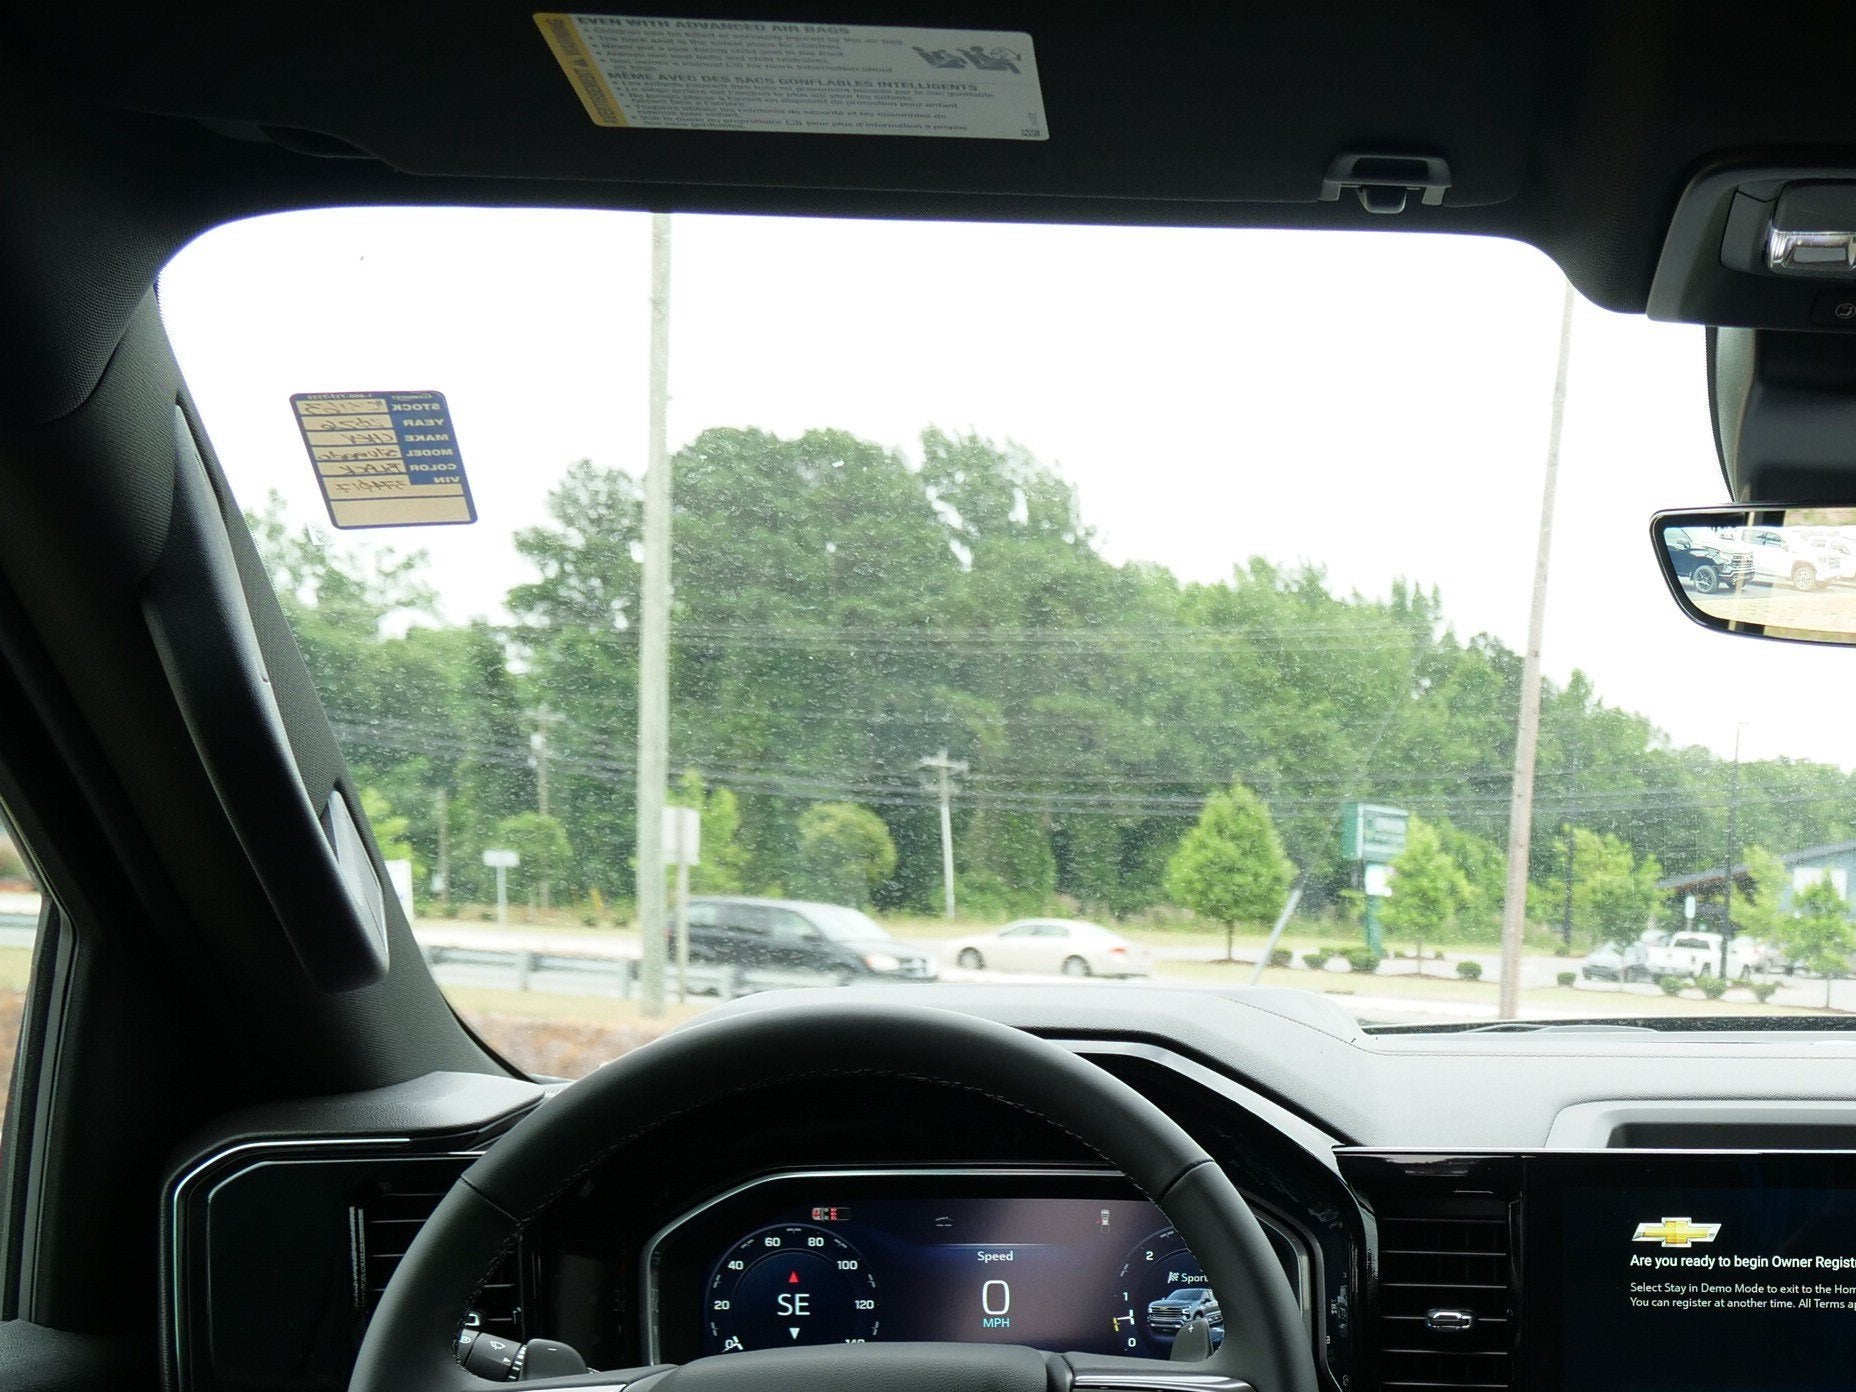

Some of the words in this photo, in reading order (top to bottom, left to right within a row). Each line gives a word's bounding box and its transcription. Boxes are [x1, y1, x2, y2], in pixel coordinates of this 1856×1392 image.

[578, 16, 621, 25] EVEN
[625, 19, 669, 27] WITH
[764, 1237, 781, 1248] 60
[807, 1237, 825, 1248] 80
[977, 1250, 1014, 1263] Speed
[1146, 1251, 1154, 1261] 2
[727, 1260, 744, 1271] 40
[837, 1260, 858, 1271] 100
[1630, 1254, 1652, 1267] Are
[1655, 1256, 1678, 1269] you
[1680, 1254, 1715, 1270] ready
[1718, 1256, 1731, 1267] to
[1734, 1254, 1769, 1270] begin
[1771, 1255, 1813, 1268] Owner
[1630, 1282, 1662, 1293] Select
[1664, 1282, 1687, 1295] Stay
[1689, 1283, 1699, 1293] in
[1701, 1283, 1732, 1293] Demo
[1734, 1283, 1765, 1294] Mode
[1766, 1284, 1778, 1294] to
[1780, 1283, 1800, 1294] exit
[1801, 1284, 1813, 1294] to
[1815, 1284, 1832, 1294] the
[982, 1279, 1010, 1315] 0
[1123, 1291, 1129, 1302] 1
[713, 1300, 730, 1311] 20
[776, 1293, 811, 1316] SE
[854, 1300, 875, 1310] 120
[1630, 1297, 1649, 1307] You
[1651, 1299, 1670, 1307] can
[1672, 1298, 1711, 1310] register
[1713, 1299, 1725, 1308] at
[1727, 1298, 1768, 1308] another
[1769, 1298, 1796, 1308] time.
[1798, 1298, 1812, 1308] All
[1813, 1298, 1846, 1309] Terms
[982, 1317, 1010, 1328] MPH
[1127, 1338, 1136, 1348] 0
